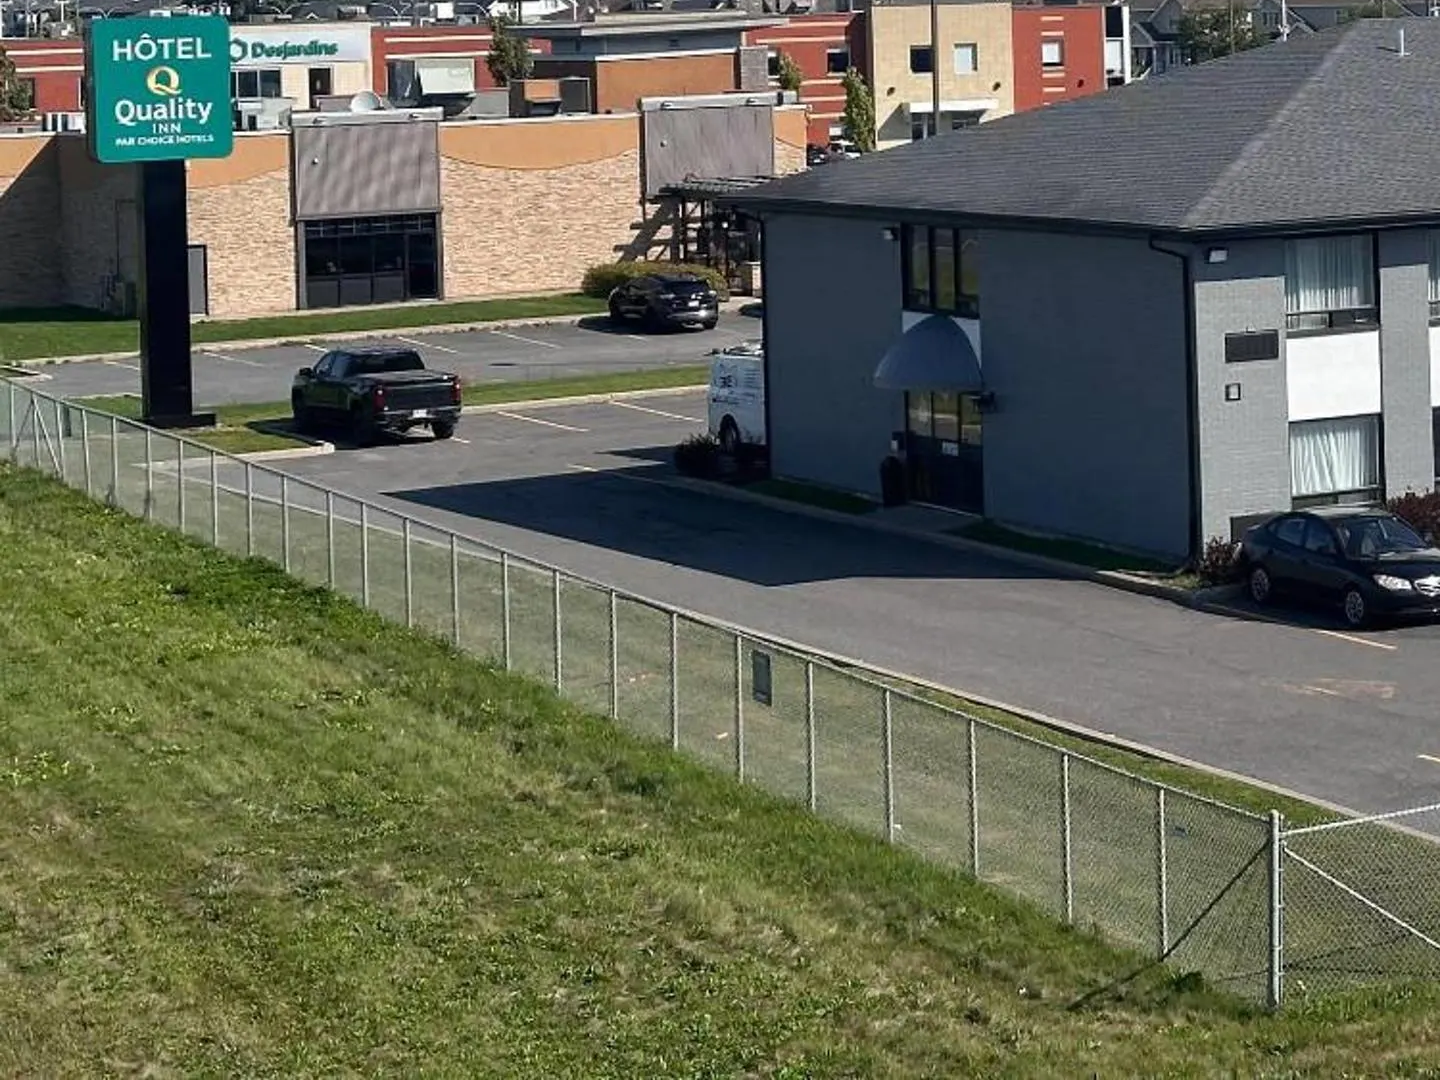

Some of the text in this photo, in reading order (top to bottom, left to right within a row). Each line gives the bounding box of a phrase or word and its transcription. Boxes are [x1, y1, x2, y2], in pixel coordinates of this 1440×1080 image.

[112, 32, 212, 61] HÔTEL
[251, 40, 339, 60] Desjardins
[146, 65, 182, 96] Q
[114, 97, 213, 126] Quality
[138, 136, 174, 146] CHOICE
[176, 133, 215, 145] HOTELS
[152, 123, 181, 134] INN
